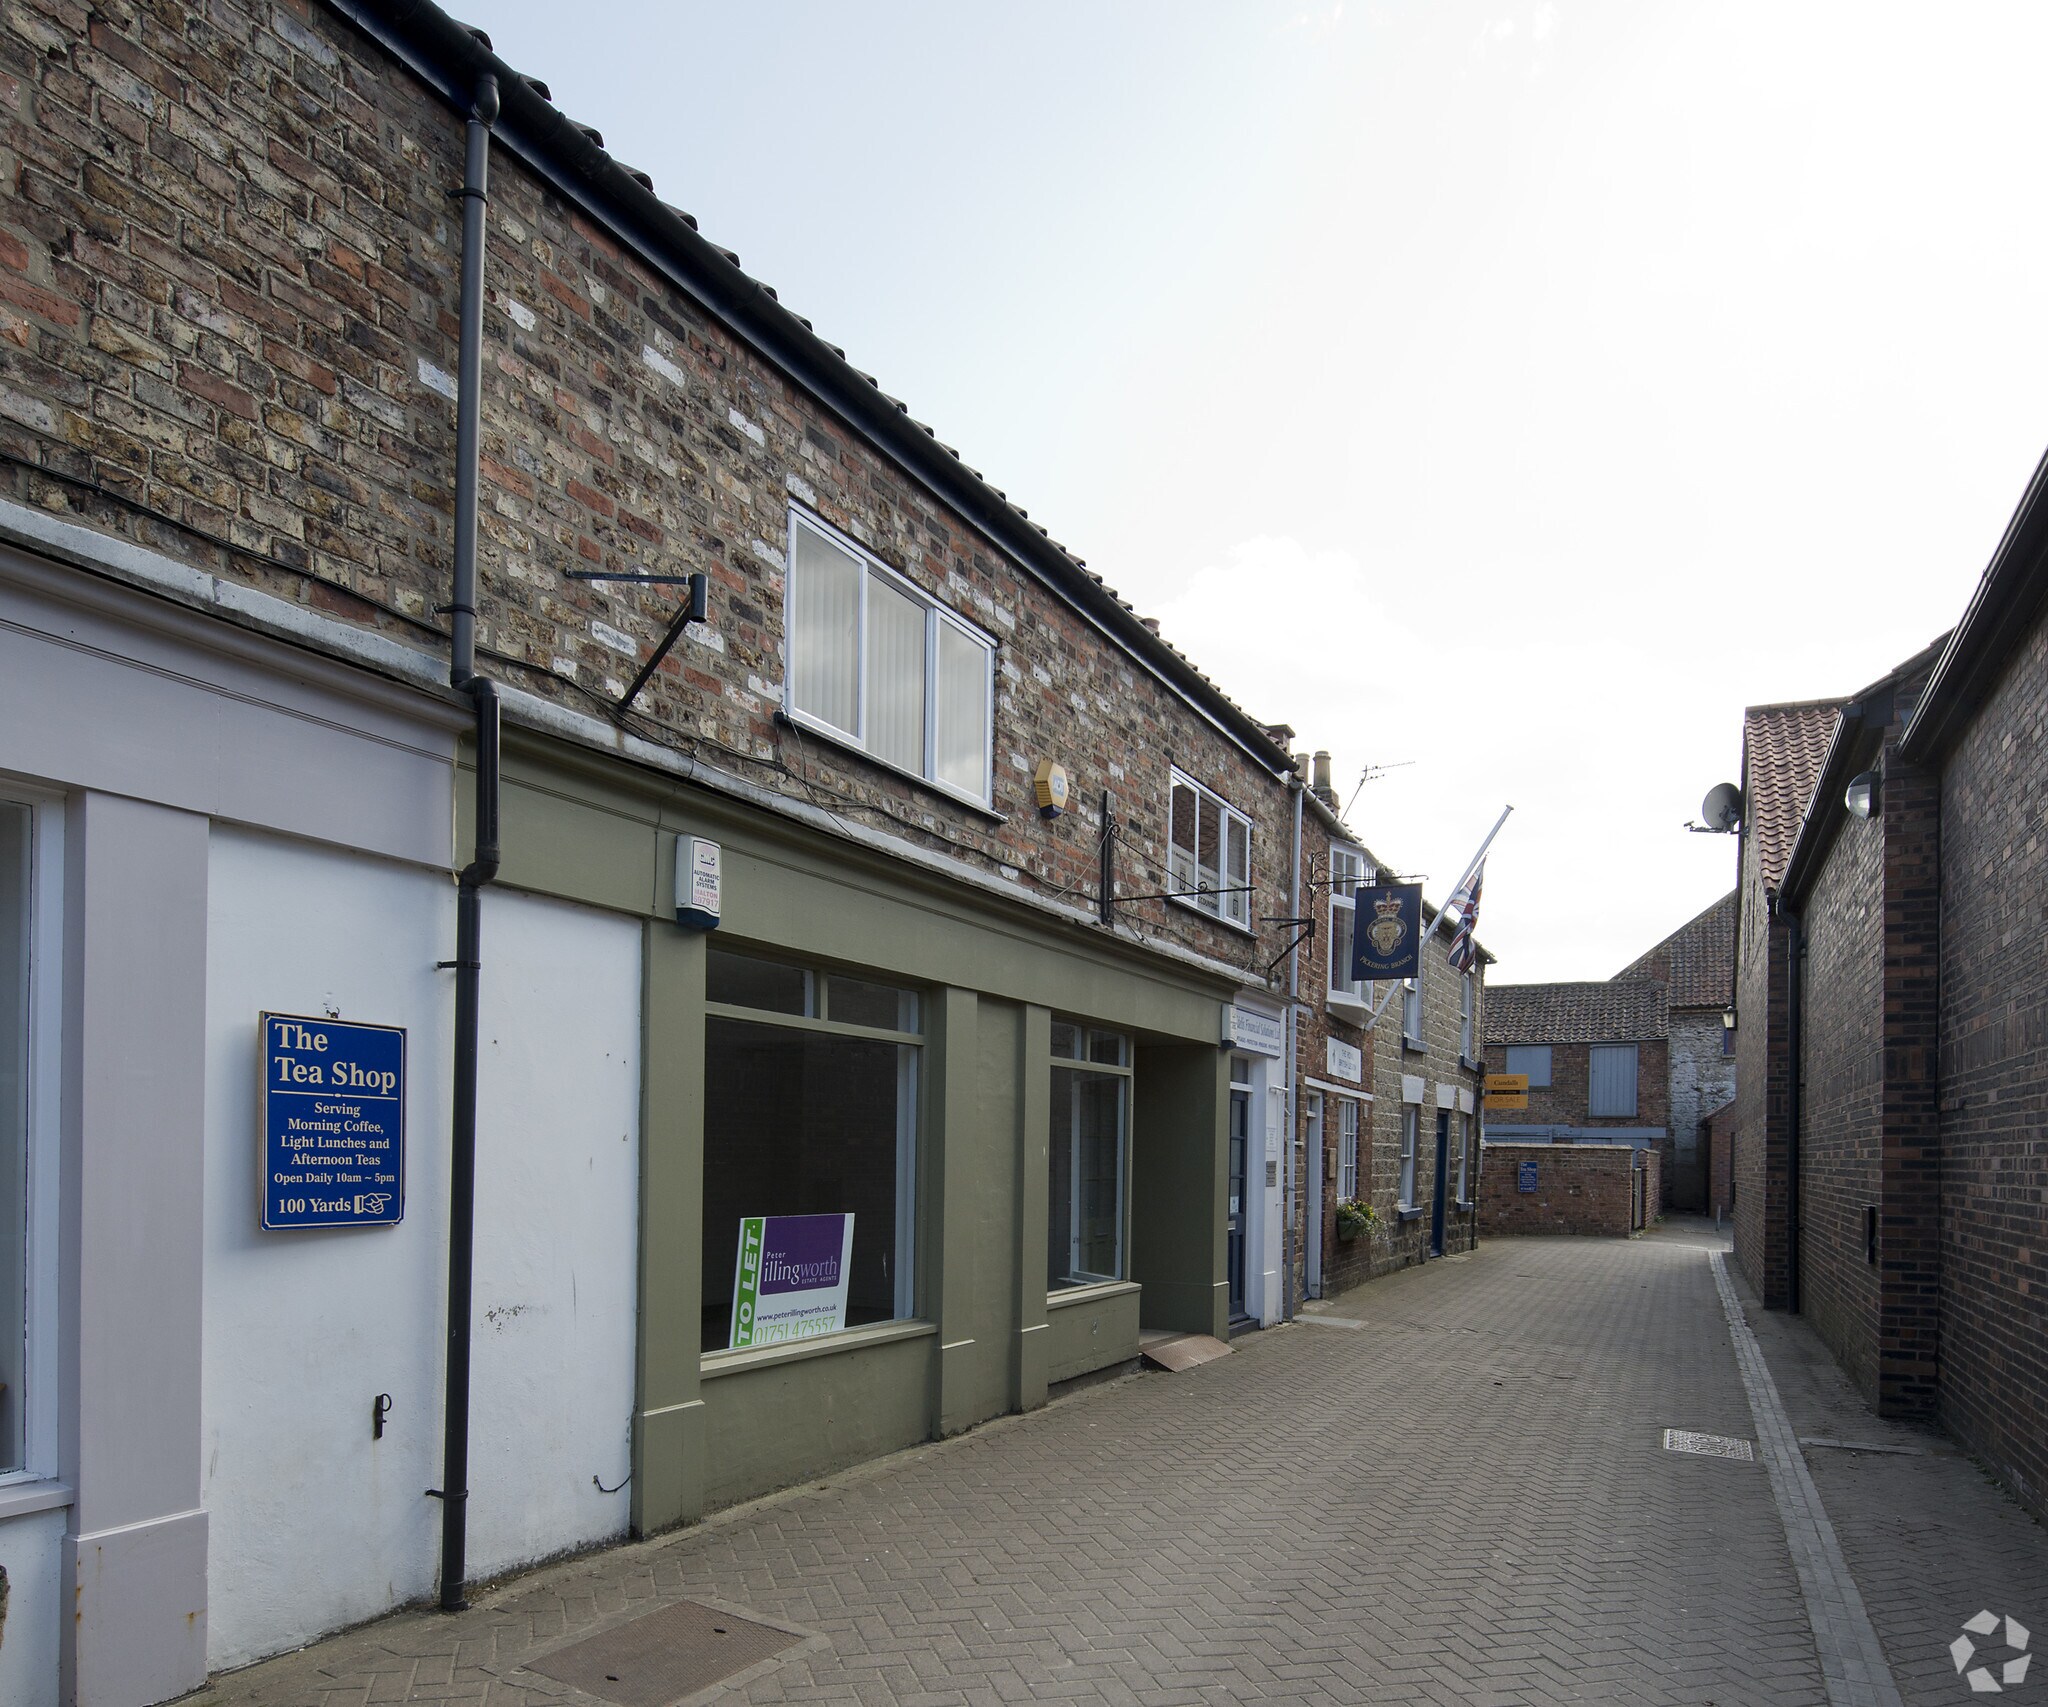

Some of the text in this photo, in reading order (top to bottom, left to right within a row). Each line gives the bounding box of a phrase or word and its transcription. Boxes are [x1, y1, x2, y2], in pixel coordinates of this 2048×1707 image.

[694, 869, 720, 881] AUTOMATIC
[699, 876, 715, 885] ALARM
[694, 889, 718, 899] MALTON
[696, 881, 717, 891] SYSTEMS
[1360, 954, 1413, 970] PICKERING BRANCH
[274, 1023, 328, 1052] The
[274, 1056, 396, 1095] Tea Shop
[1490, 1096, 1504, 1104] FOR
[314, 1102, 361, 1118] Serving
[288, 1118, 384, 1134] Morning Coffee,
[281, 1135, 390, 1150] Light Lunches and
[290, 1153, 381, 1165] Afternoon Teas
[274, 1172, 303, 1185] Open
[305, 1172, 333, 1185] Daily
[336, 1172, 362, 1182] 10am
[374, 1172, 395, 1184] 5pm
[279, 1197, 352, 1213] 100 Yards
[766, 1251, 786, 1259] Peter
[764, 1255, 837, 1285] illingworth
[757, 1303, 837, 1322] www.peterillingworth.co.uk
[737, 1301, 752, 1344] TO
[754, 1315, 836, 1344] 01751 475557
